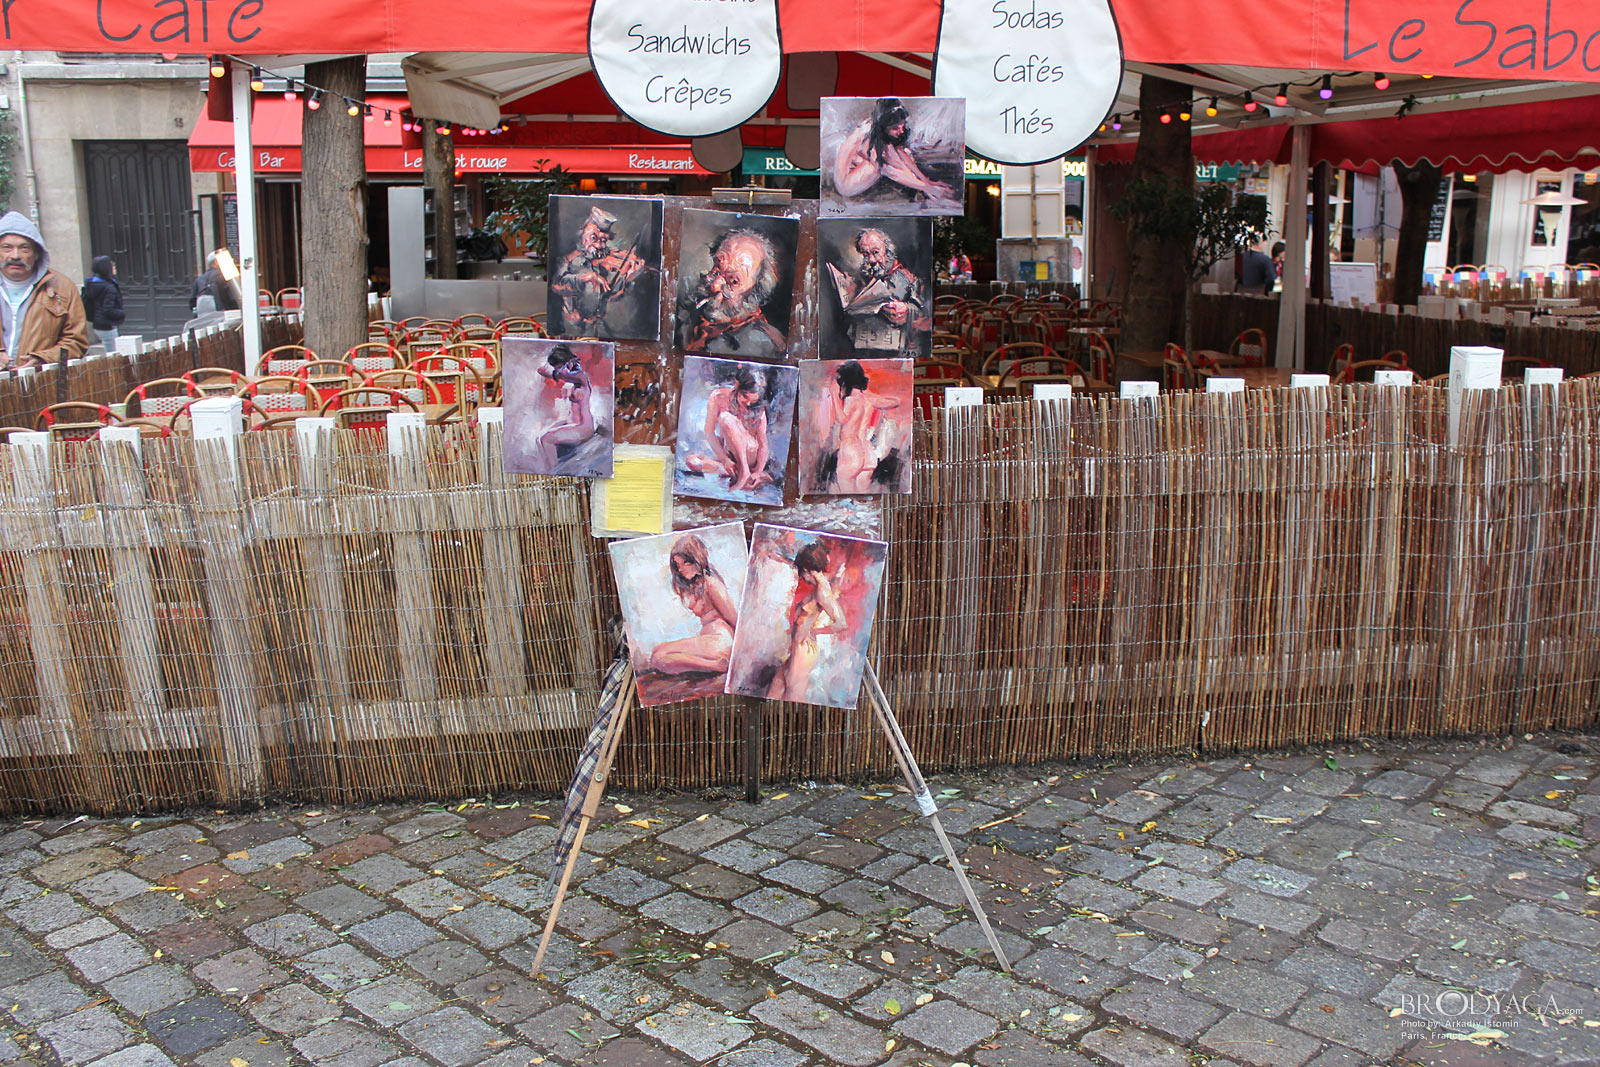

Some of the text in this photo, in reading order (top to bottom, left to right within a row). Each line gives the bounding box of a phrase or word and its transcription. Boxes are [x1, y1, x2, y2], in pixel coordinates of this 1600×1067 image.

[992, 0, 1064, 29] Sodas
[627, 23, 751, 56] Sandwichs
[1343, 0, 1425, 63] Le
[993, 54, 1064, 83] Cafés
[645, 75, 732, 111] Crêpes
[999, 106, 1054, 134] Thés
[218, 152, 285, 168] Ca Bar
[404, 151, 422, 168] Le
[629, 153, 695, 170] Restaurant
